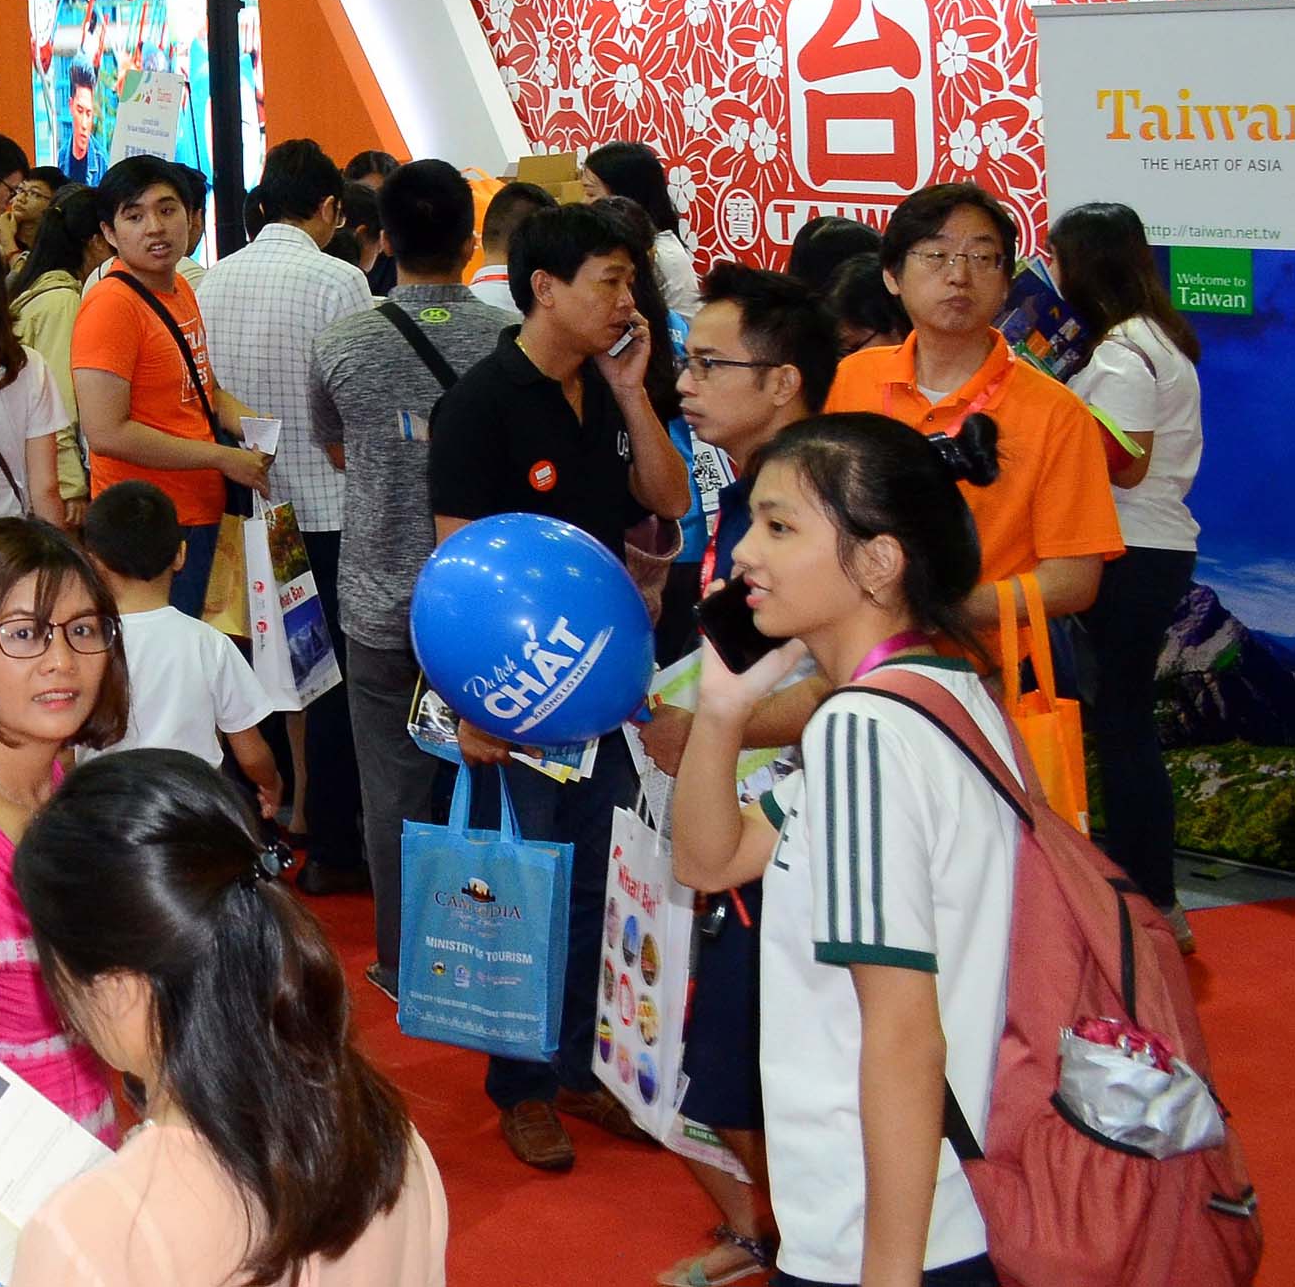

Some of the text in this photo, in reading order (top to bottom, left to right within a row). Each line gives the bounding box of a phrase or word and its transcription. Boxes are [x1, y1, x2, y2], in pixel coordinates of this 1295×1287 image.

[1141, 157, 1282, 173] THE HEART OF ASIA
[1176, 273, 1246, 288] Welcome to
[1177, 286, 1246, 309] Taiwan
[484, 615, 586, 719] CHẤT
[463, 674, 496, 699] Du
[425, 935, 475, 955] MINISTRY
[484, 951, 533, 965] TOURISM
